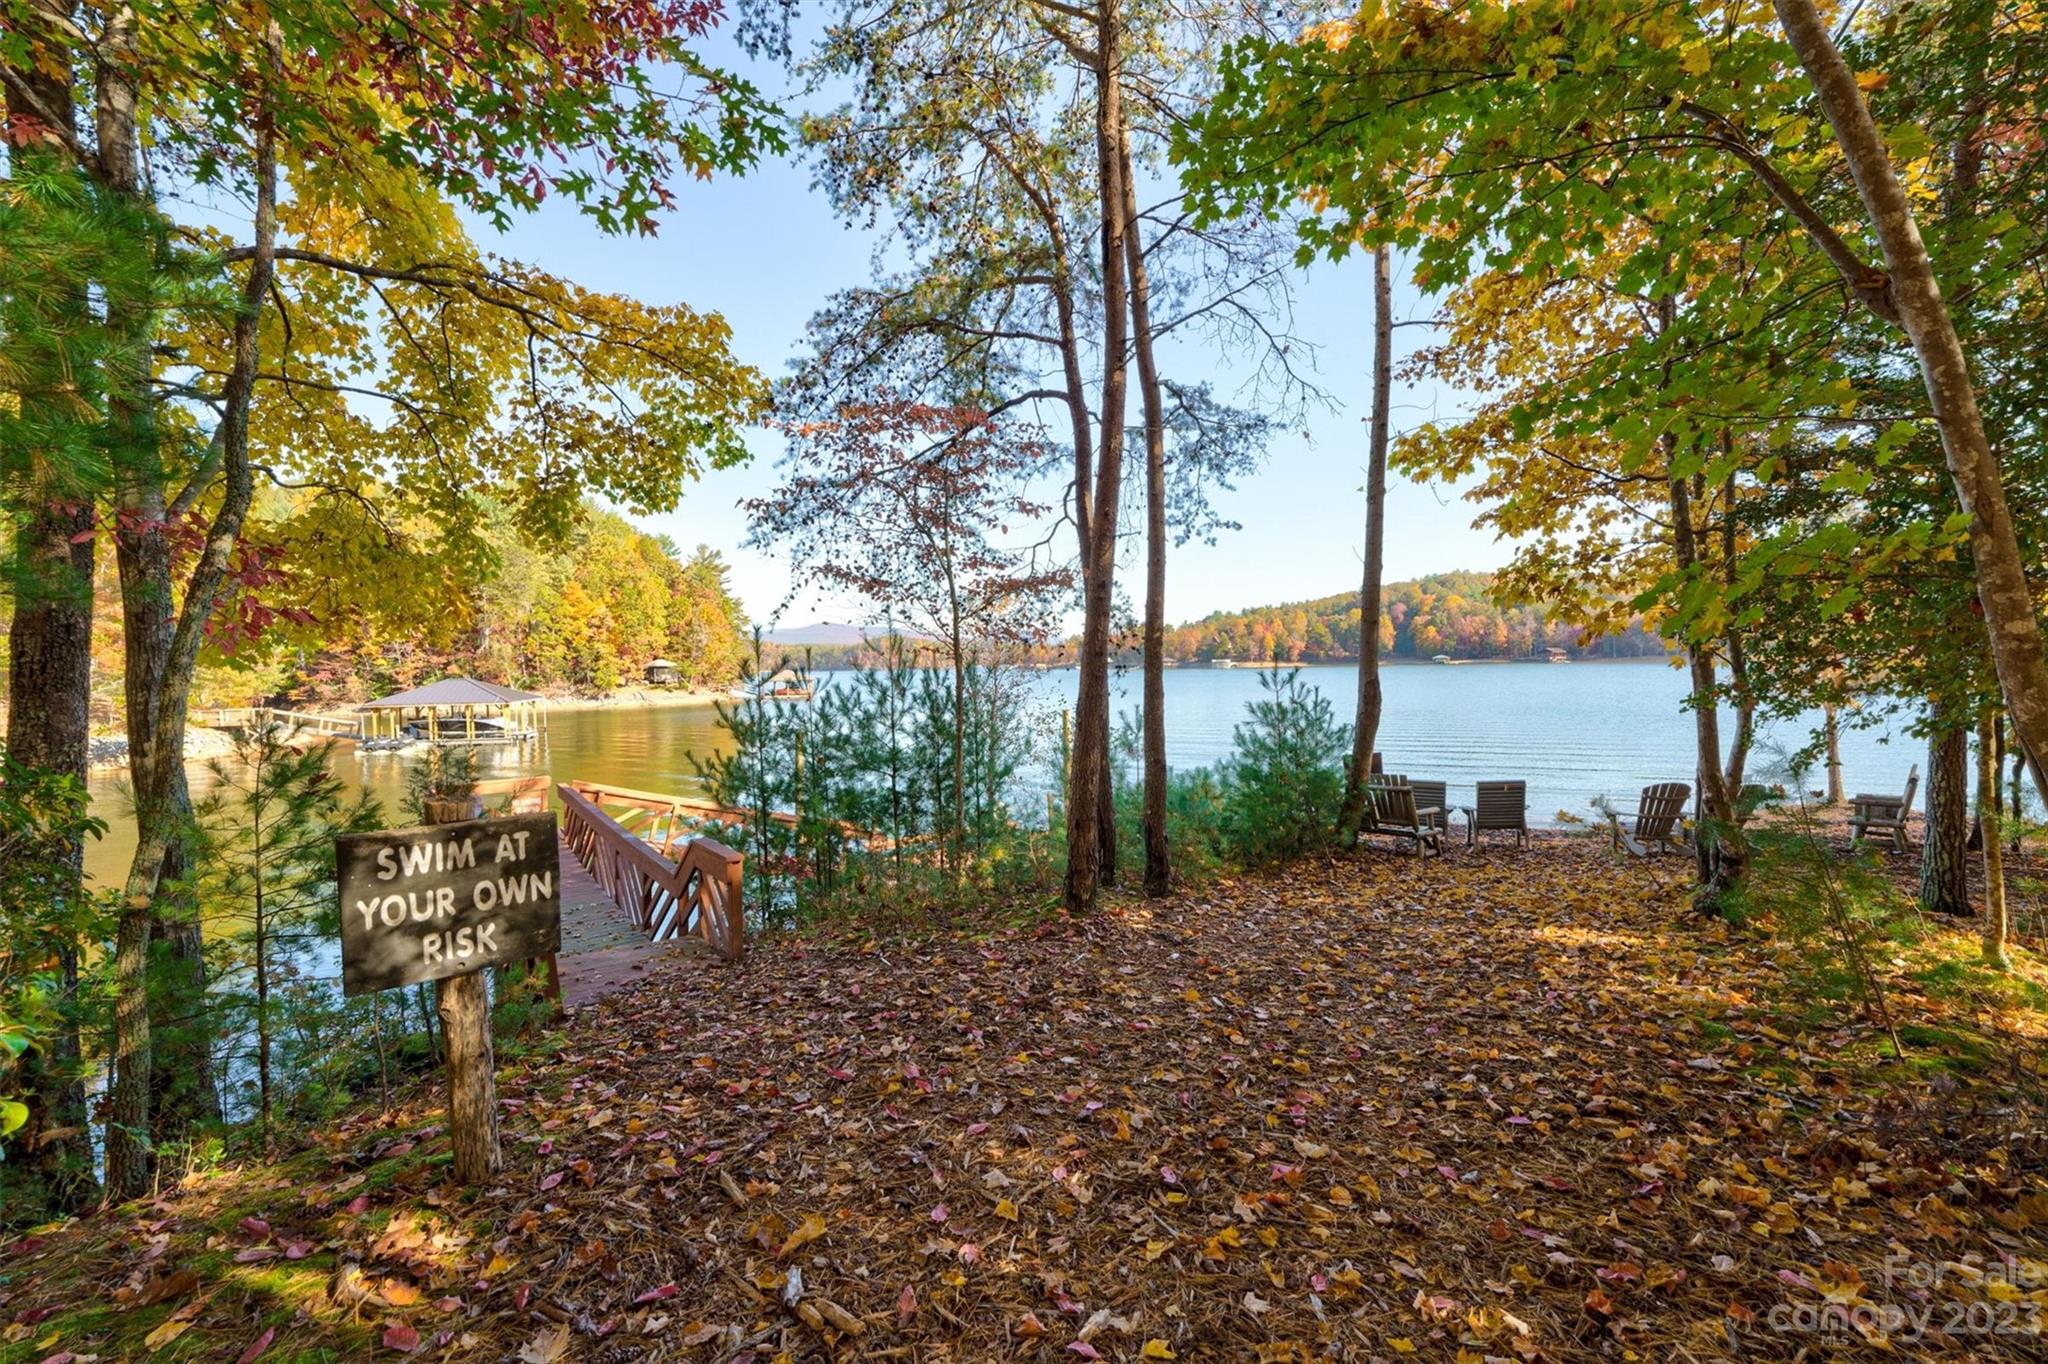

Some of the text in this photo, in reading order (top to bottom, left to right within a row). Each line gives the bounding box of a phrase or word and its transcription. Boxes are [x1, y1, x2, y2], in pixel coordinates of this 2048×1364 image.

[377, 831, 530, 880] SWIM AT
[356, 871, 552, 930] YOUR OWN
[422, 922, 498, 965] RISK
